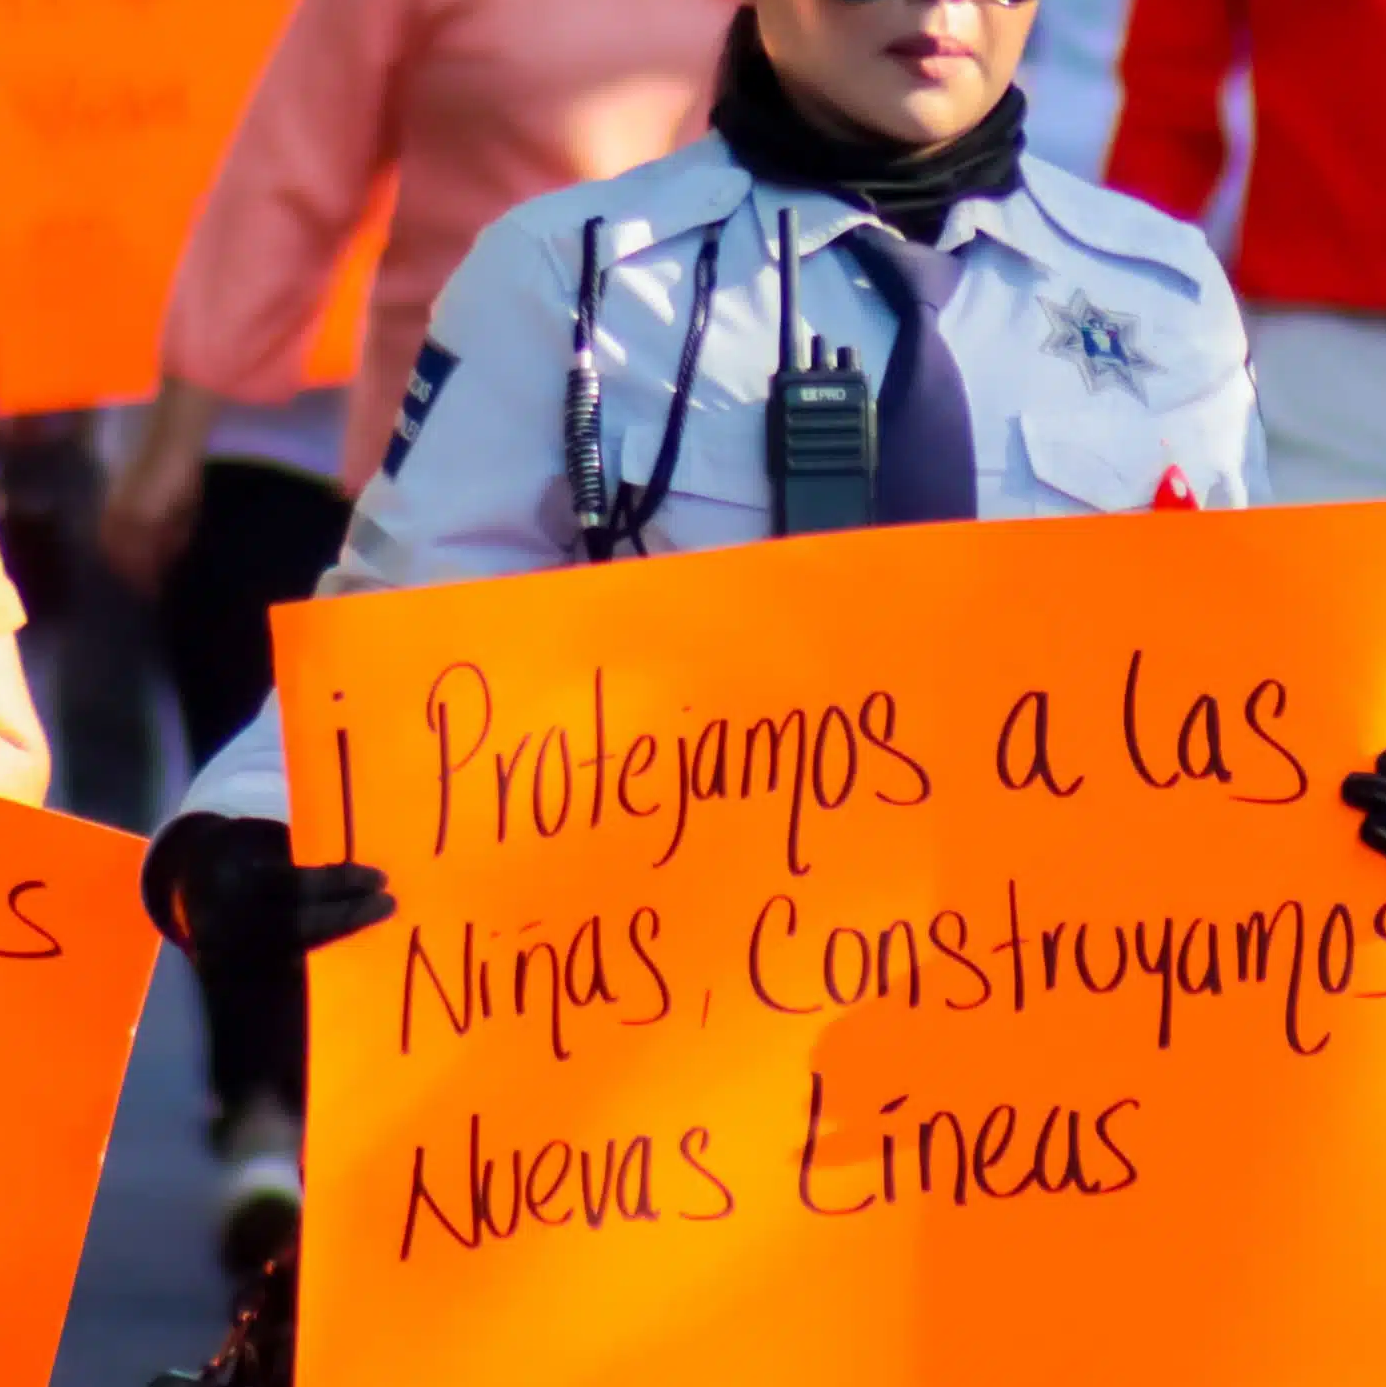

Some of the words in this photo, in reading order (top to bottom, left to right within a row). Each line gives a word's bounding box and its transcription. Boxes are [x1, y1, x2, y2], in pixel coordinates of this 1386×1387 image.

[424, 660, 931, 876] Protejamos
[996, 690, 1085, 798] a
[399, 1113, 736, 1262] Nuevas
